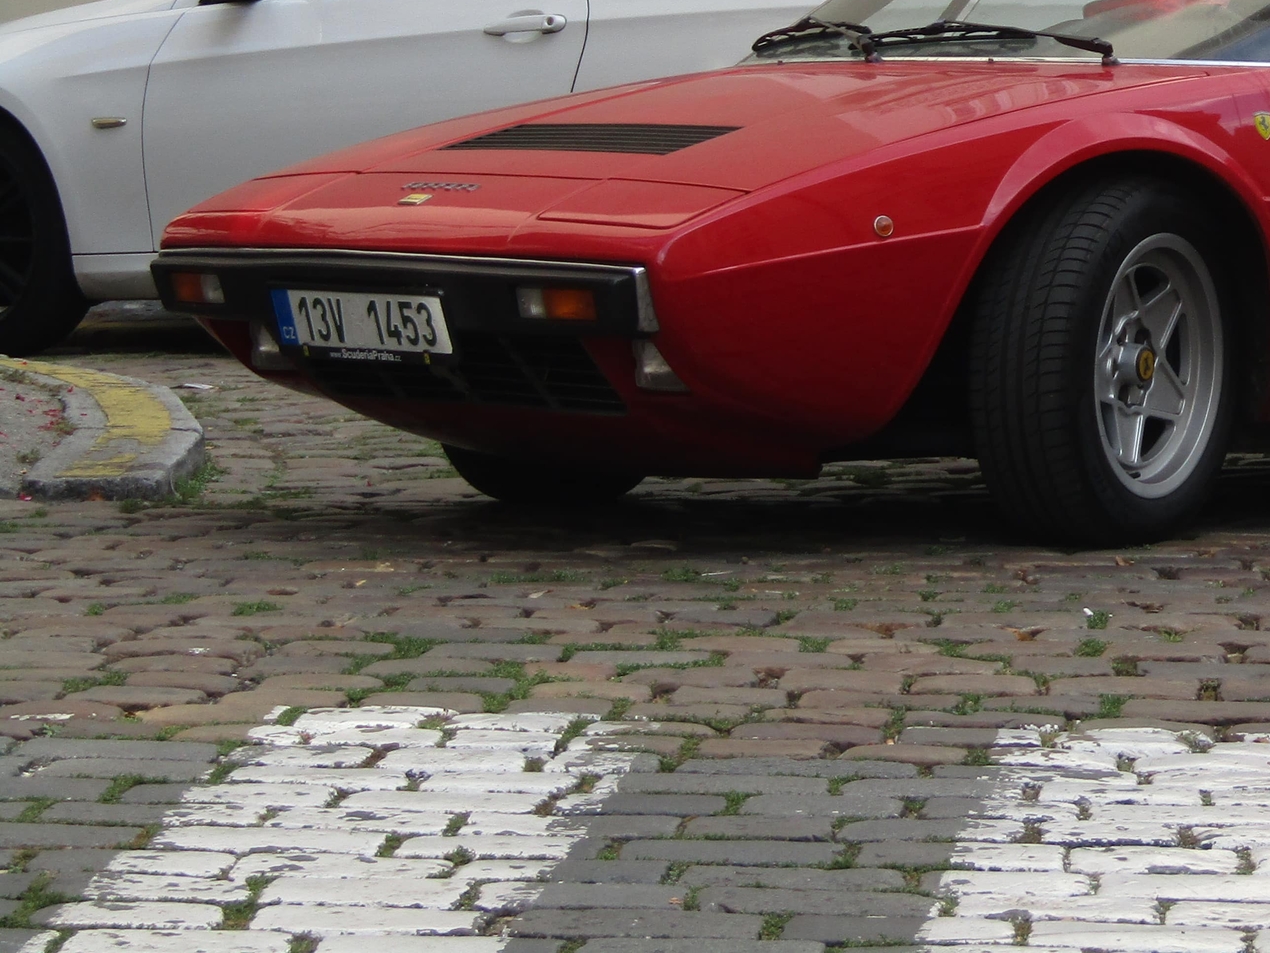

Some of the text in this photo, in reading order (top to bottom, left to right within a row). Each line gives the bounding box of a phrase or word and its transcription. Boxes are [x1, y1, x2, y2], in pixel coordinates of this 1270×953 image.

[282, 326, 296, 339] CZ
[298, 296, 437, 348] 13V 1453
